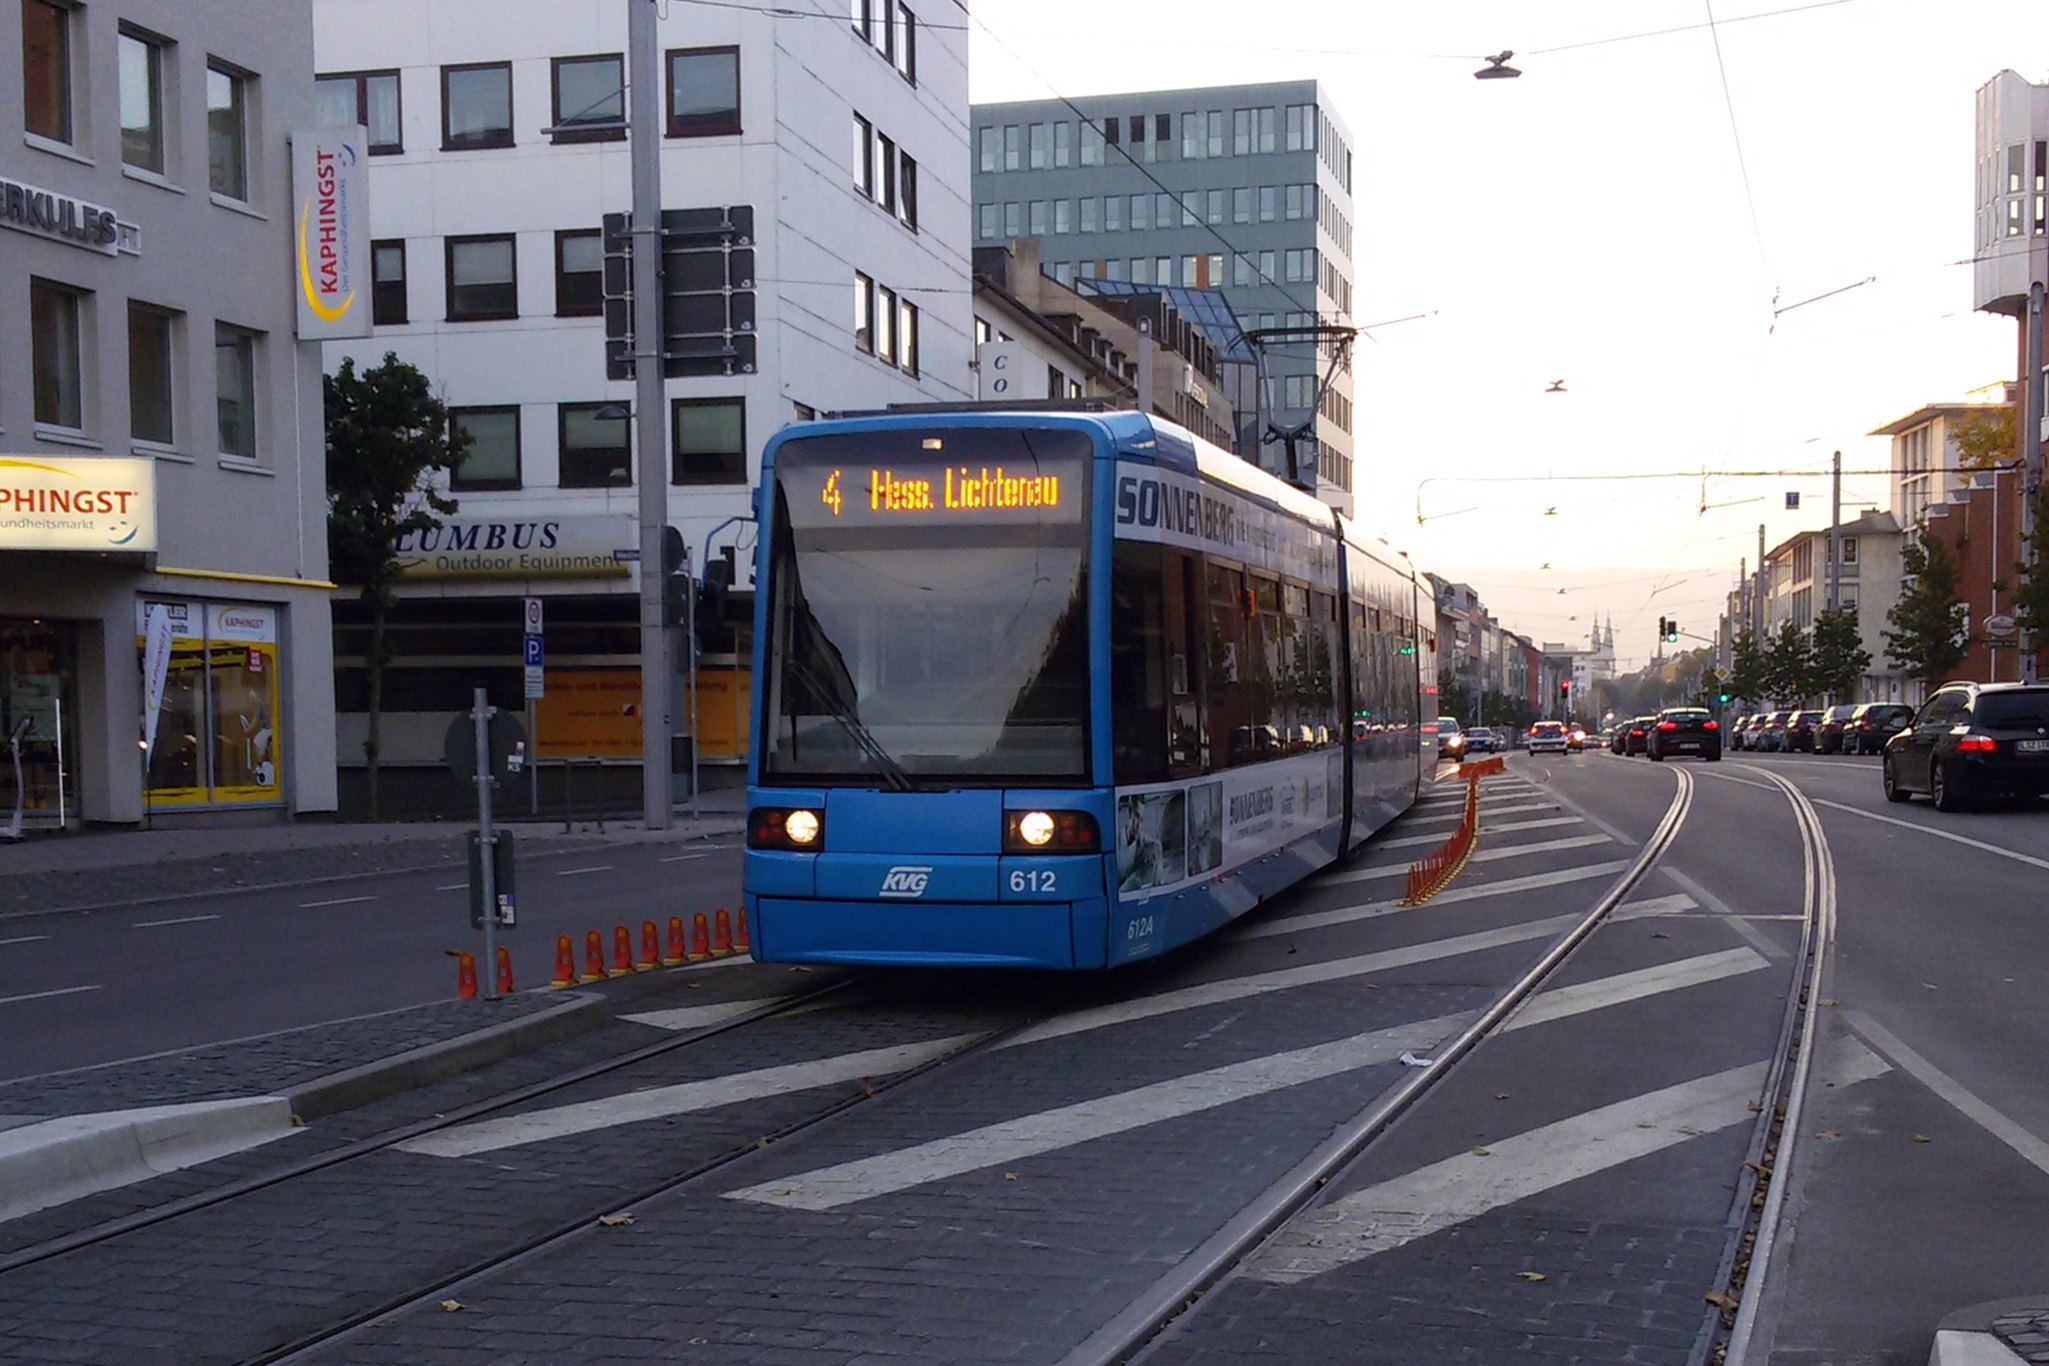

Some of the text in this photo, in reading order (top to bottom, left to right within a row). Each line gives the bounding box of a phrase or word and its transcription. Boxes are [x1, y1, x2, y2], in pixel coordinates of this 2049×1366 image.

[317, 150, 338, 294] KAPHINGST
[0, 488, 132, 514] PHINGST
[822, 467, 1058, 516] 4 Hess. Lichtenau
[0, 518, 94, 530] undheitsmarkt
[1117, 476, 1234, 546] SONNENBERG
[436, 554, 513, 572] Outdoor
[880, 869, 931, 895] KVG
[1010, 871, 1056, 892] 612
[1127, 914, 1153, 939] 612A
